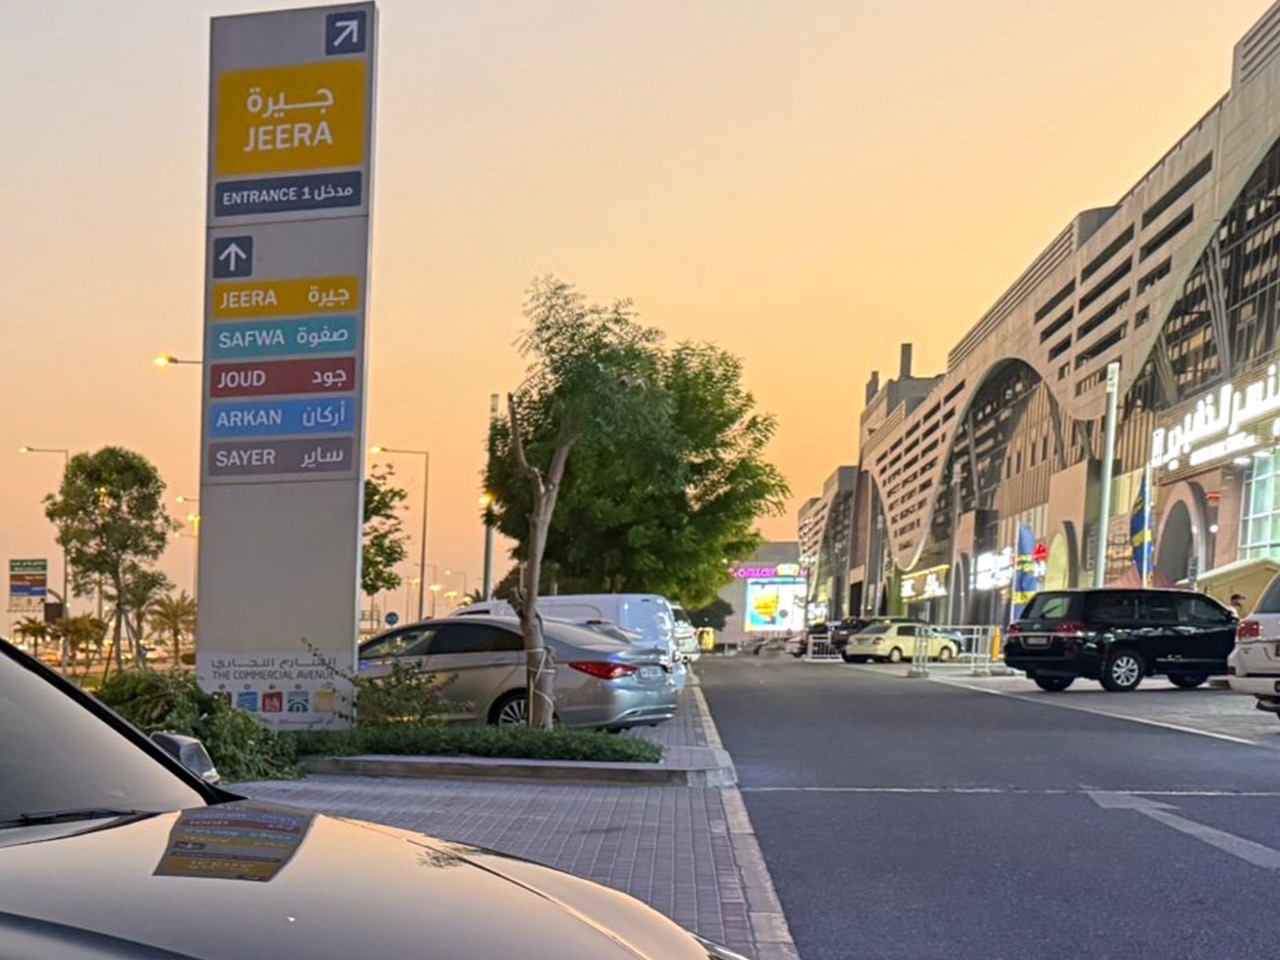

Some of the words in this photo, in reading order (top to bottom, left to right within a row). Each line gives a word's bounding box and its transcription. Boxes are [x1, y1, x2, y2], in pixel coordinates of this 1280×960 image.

[246, 87, 334, 118] جيرة
[243, 121, 333, 152] JEERA
[222, 187, 297, 205] ENTRANCE
[301, 186, 310, 200] 1
[314, 185, 353, 201] مدخل
[220, 289, 278, 309] JEERA
[308, 286, 350, 307] جيرة
[219, 329, 285, 348] SAFWA
[296, 327, 349, 348] صفوة
[217, 370, 266, 389] JOUD
[311, 369, 347, 388] جود
[215, 410, 282, 428] ARKAN
[302, 401, 345, 427] أركان
[215, 449, 276, 467] SAYER
[300, 446, 344, 468] ساير
[212, 670, 231, 680] THE
